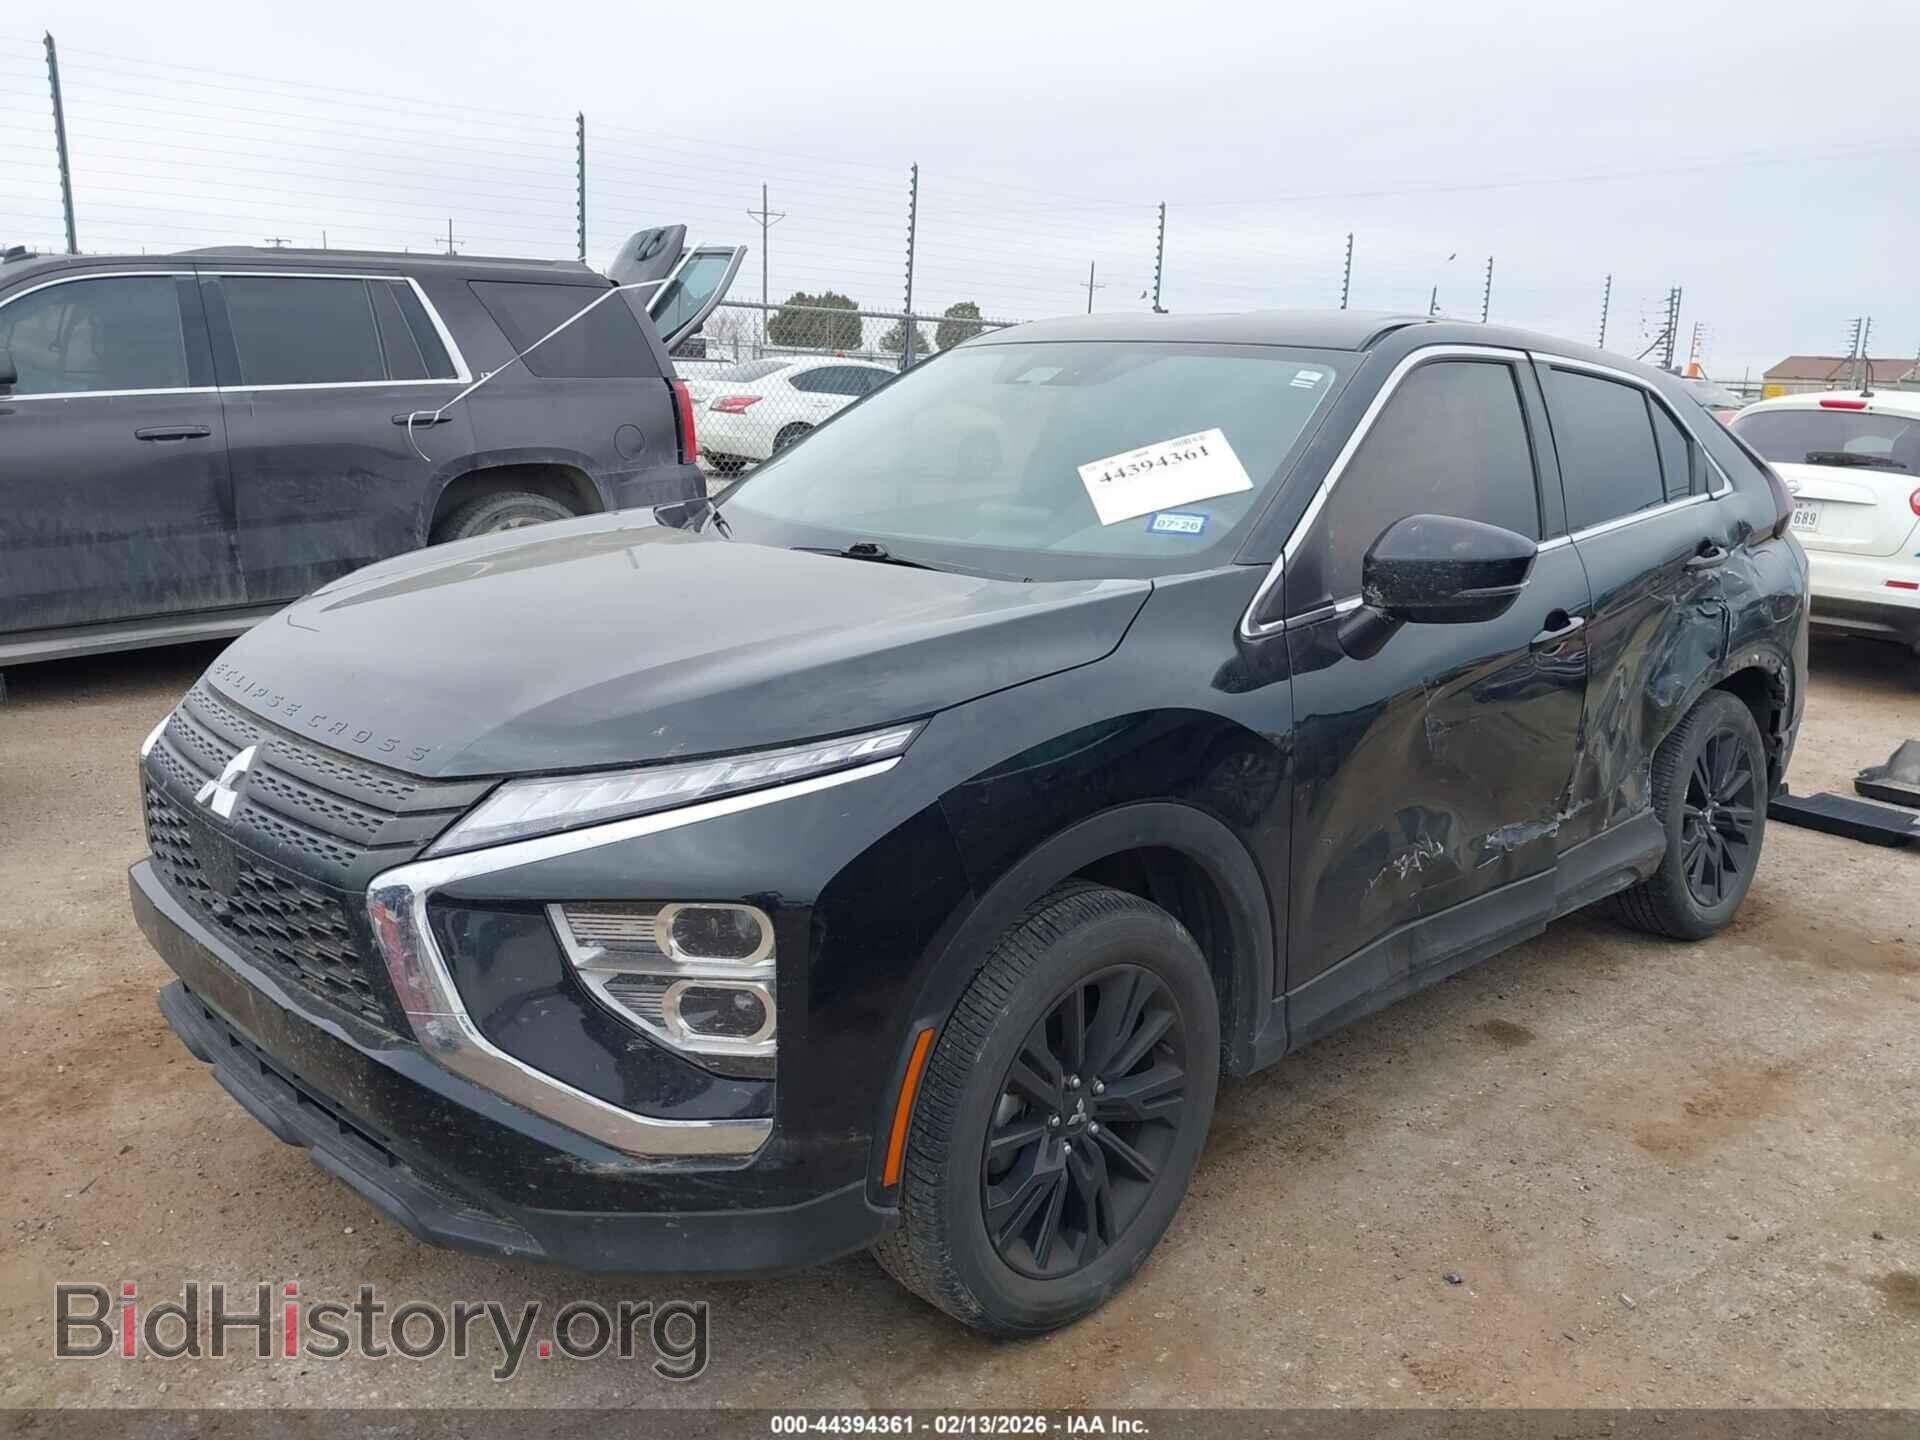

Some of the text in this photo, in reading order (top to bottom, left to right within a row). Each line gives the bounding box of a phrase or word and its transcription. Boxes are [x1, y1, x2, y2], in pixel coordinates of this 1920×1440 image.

[1099, 445, 1209, 483] 44394361
[215, 663, 431, 762] ECLIPSE CROSS
